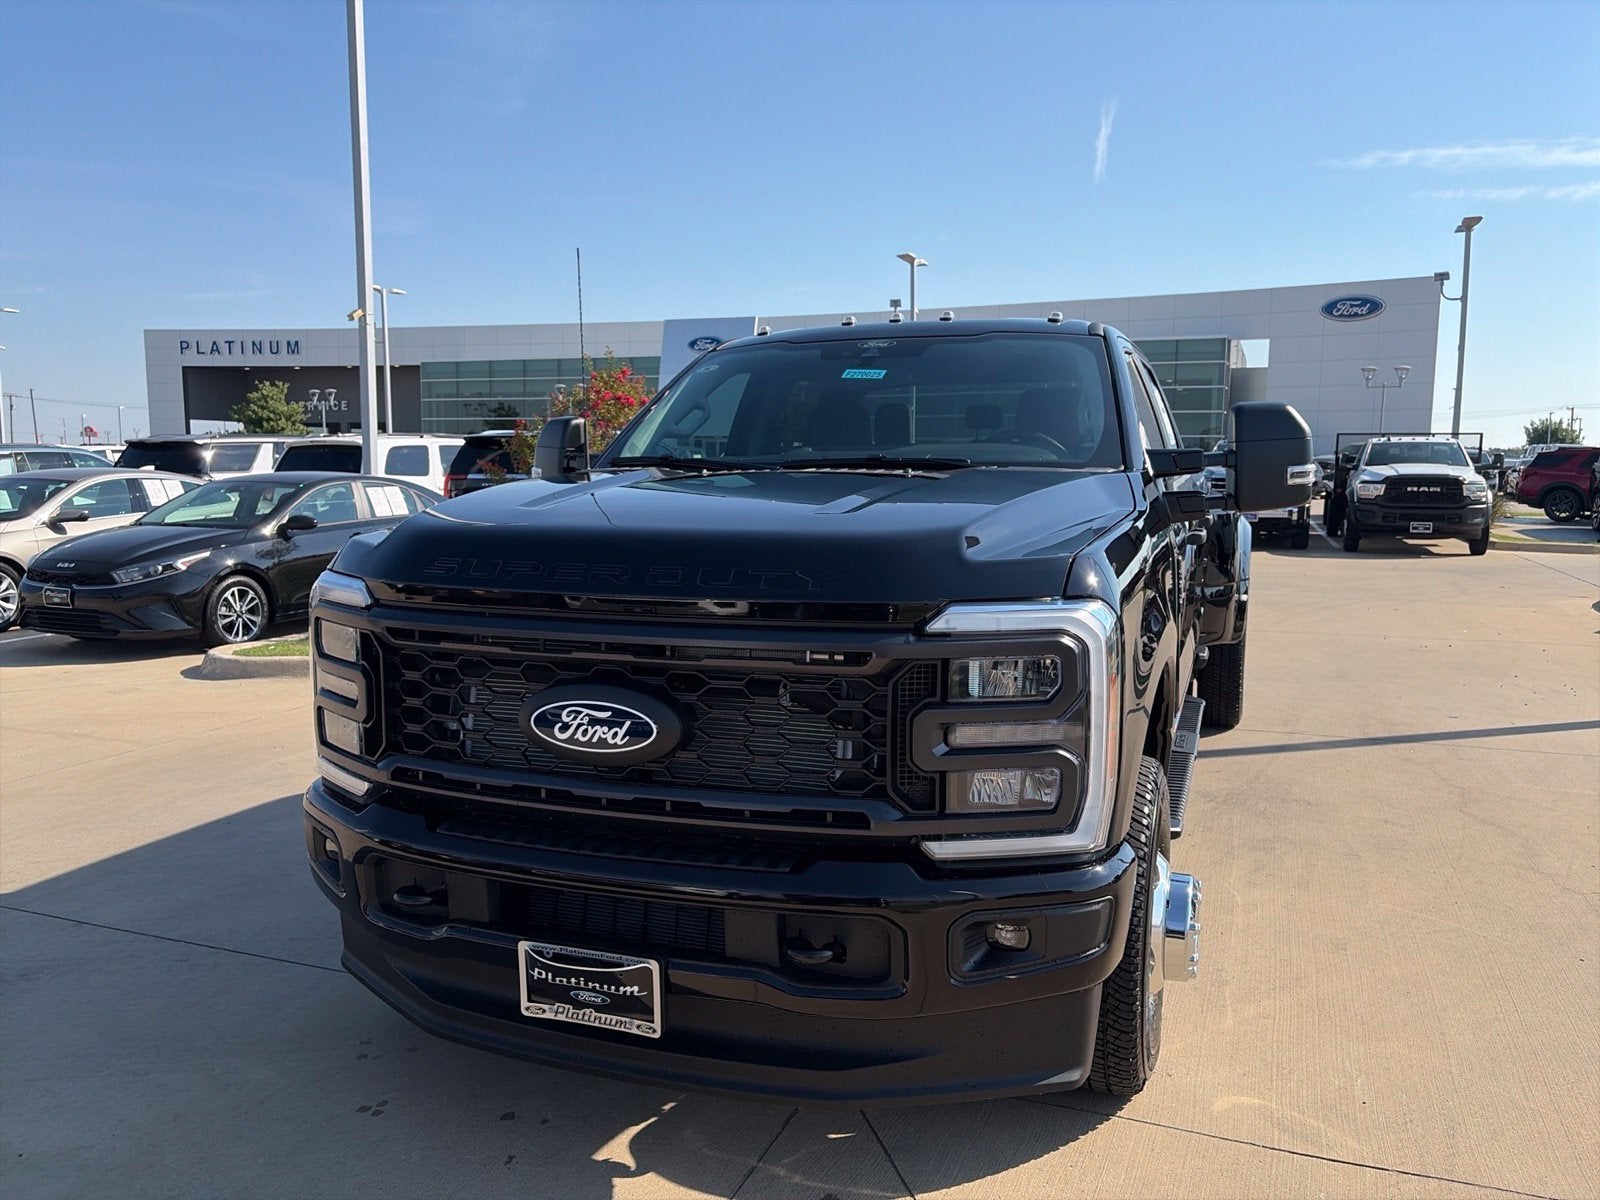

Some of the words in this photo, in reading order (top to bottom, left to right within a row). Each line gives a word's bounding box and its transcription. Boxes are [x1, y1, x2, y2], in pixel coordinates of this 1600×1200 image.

[1332, 300, 1371, 316] Ford
[179, 340, 301, 355] PLATINUM
[694, 339, 718, 351] Ford
[423, 556, 632, 585] SUPER
[645, 564, 839, 591] DUTY
[553, 706, 632, 746] Ford
[528, 967, 649, 996] Platinum
[578, 992, 604, 1003] Ford
[554, 1004, 634, 1031] Platinum
